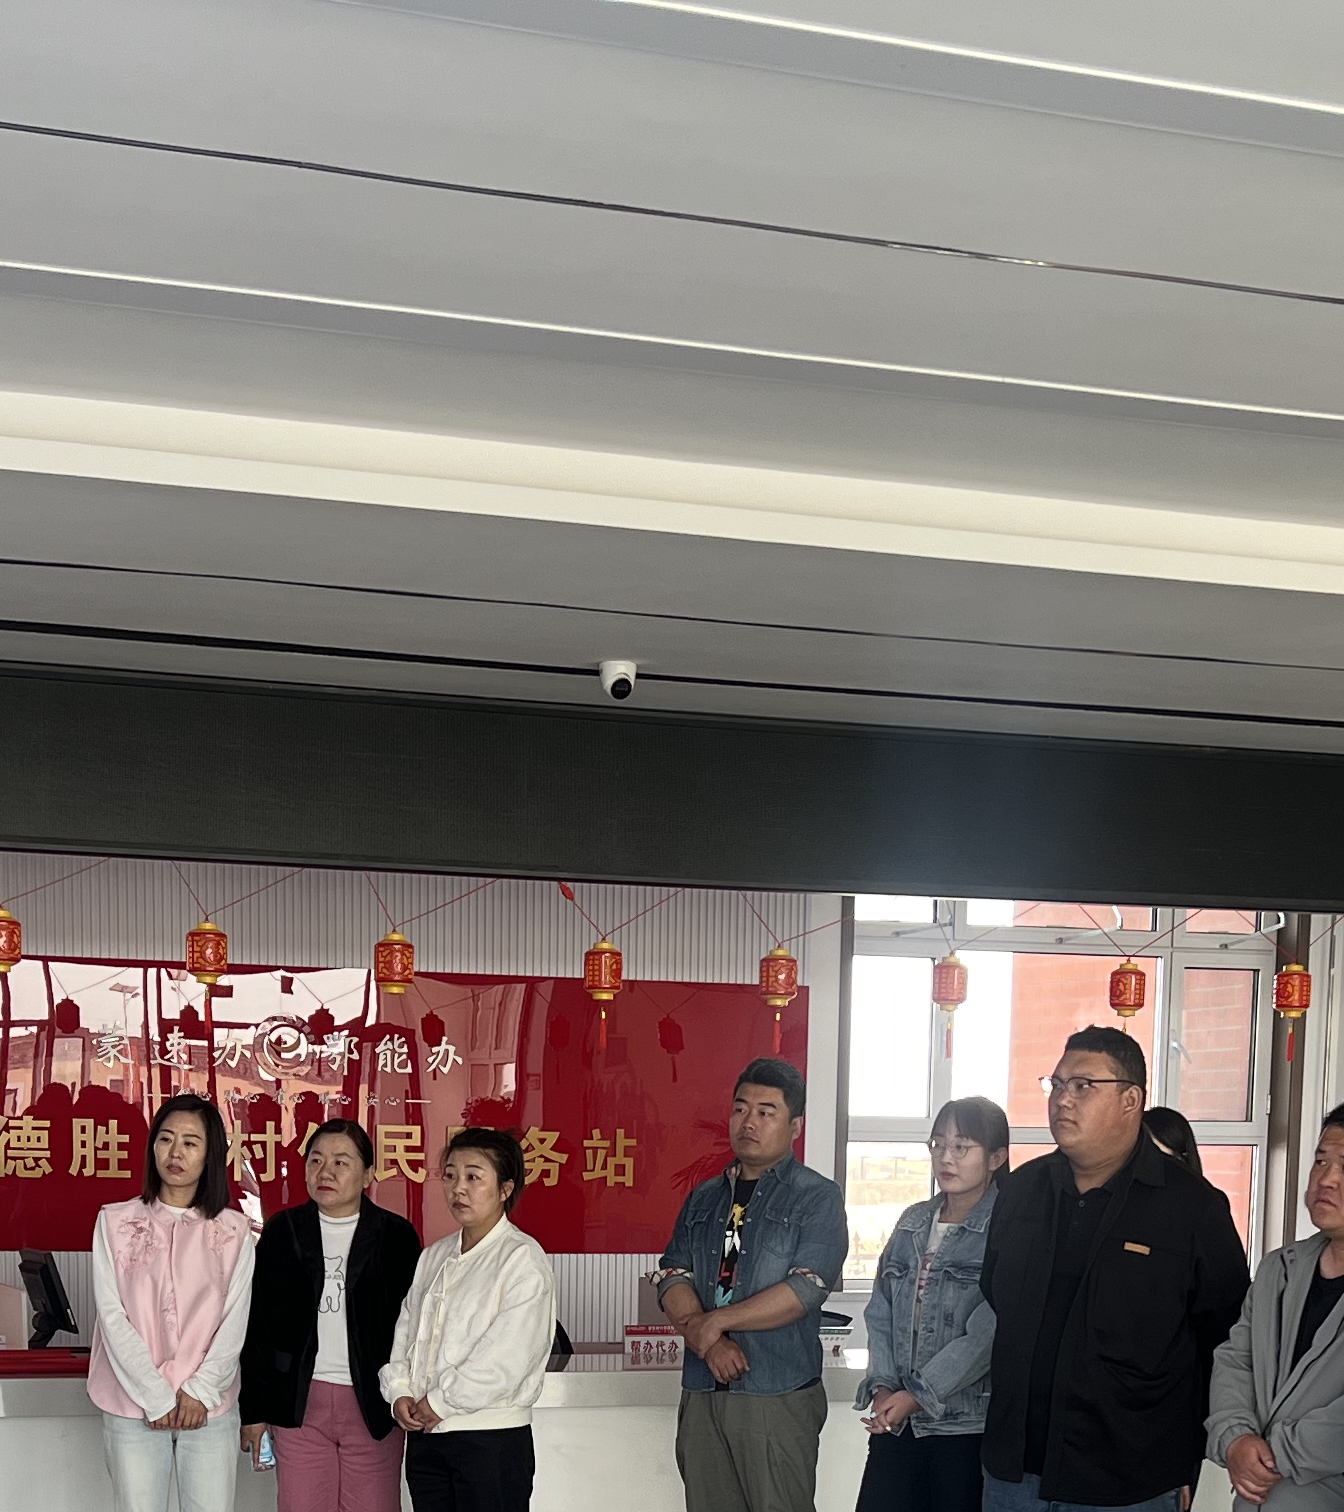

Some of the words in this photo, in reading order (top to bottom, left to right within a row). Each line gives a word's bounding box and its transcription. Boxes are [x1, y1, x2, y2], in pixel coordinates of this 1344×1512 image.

[92, 1020, 251, 1070] 蒙速办
[322, 1029, 463, 1076] 鄂能办
